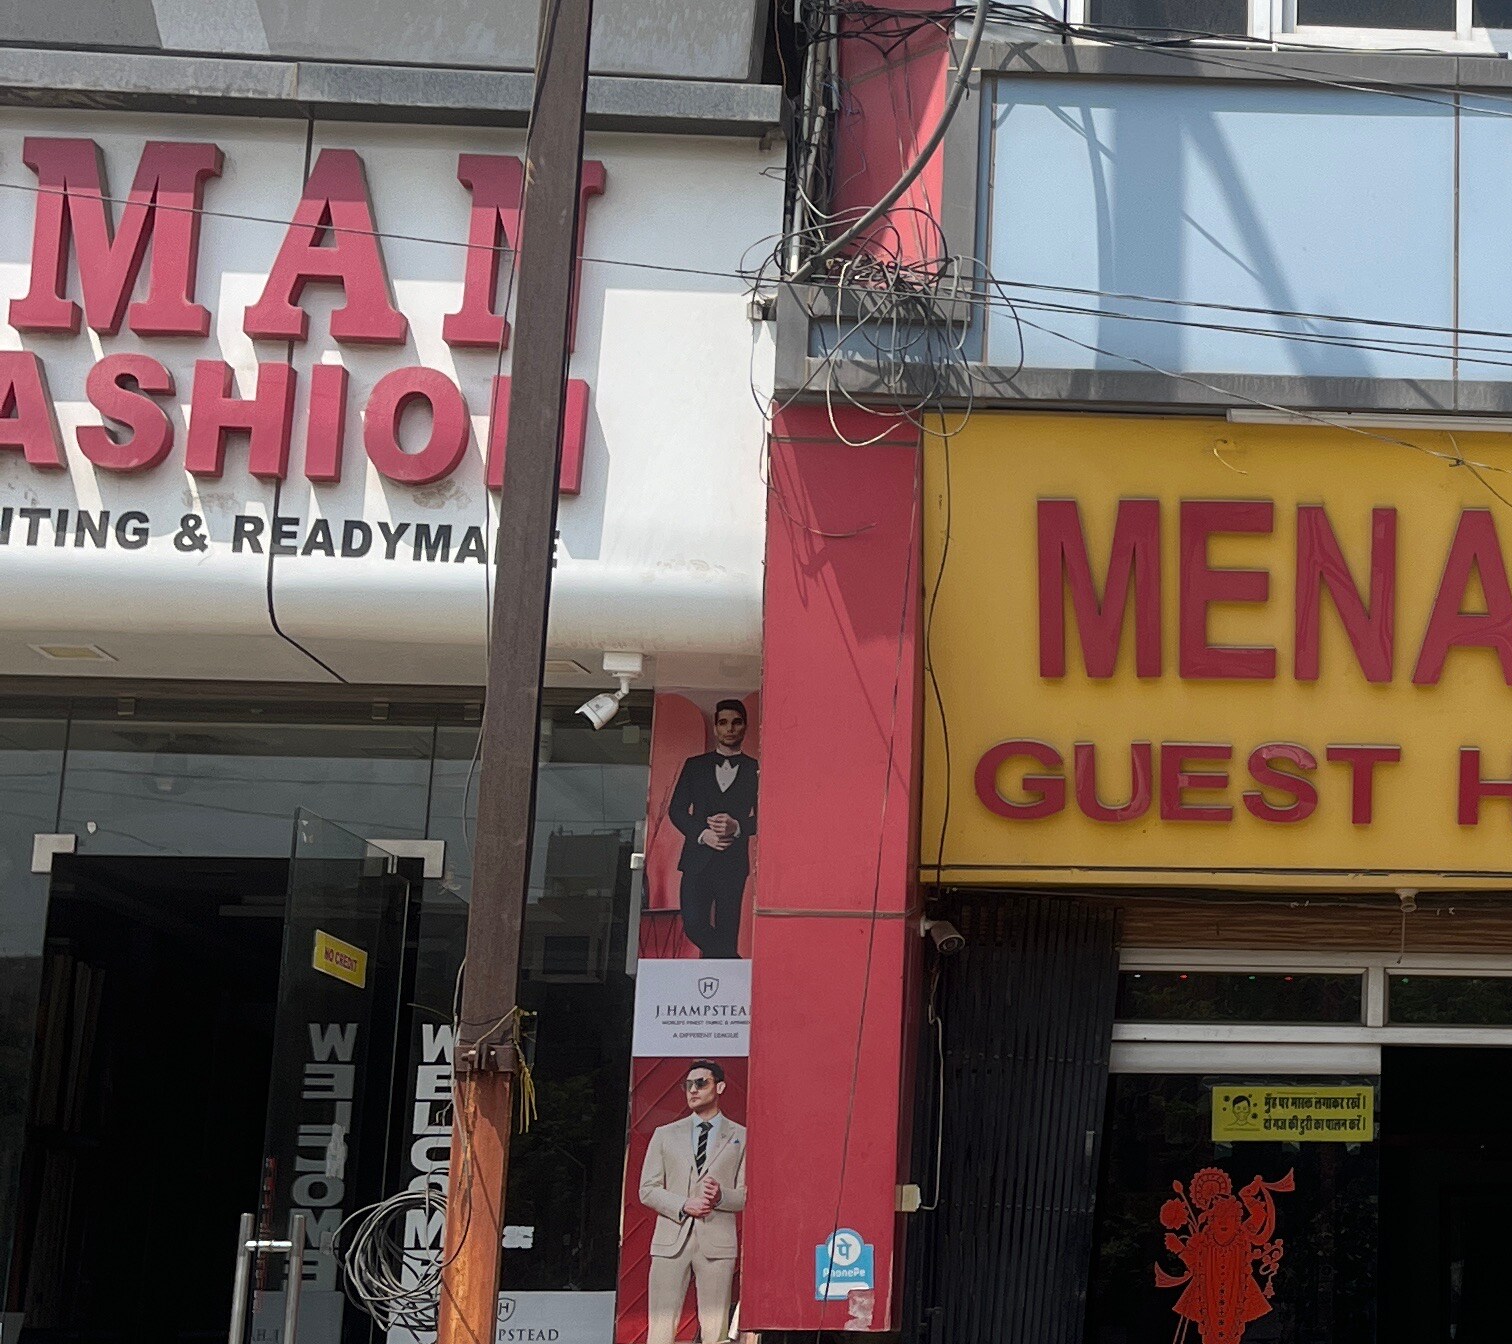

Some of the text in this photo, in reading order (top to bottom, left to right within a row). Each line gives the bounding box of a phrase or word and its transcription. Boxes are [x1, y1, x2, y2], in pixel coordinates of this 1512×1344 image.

[174, 513, 208, 553] &
[231, 514, 560, 569] READYMA
[974, 737, 1400, 825] GUEST
[822, 1267, 866, 1277] PhonePe
